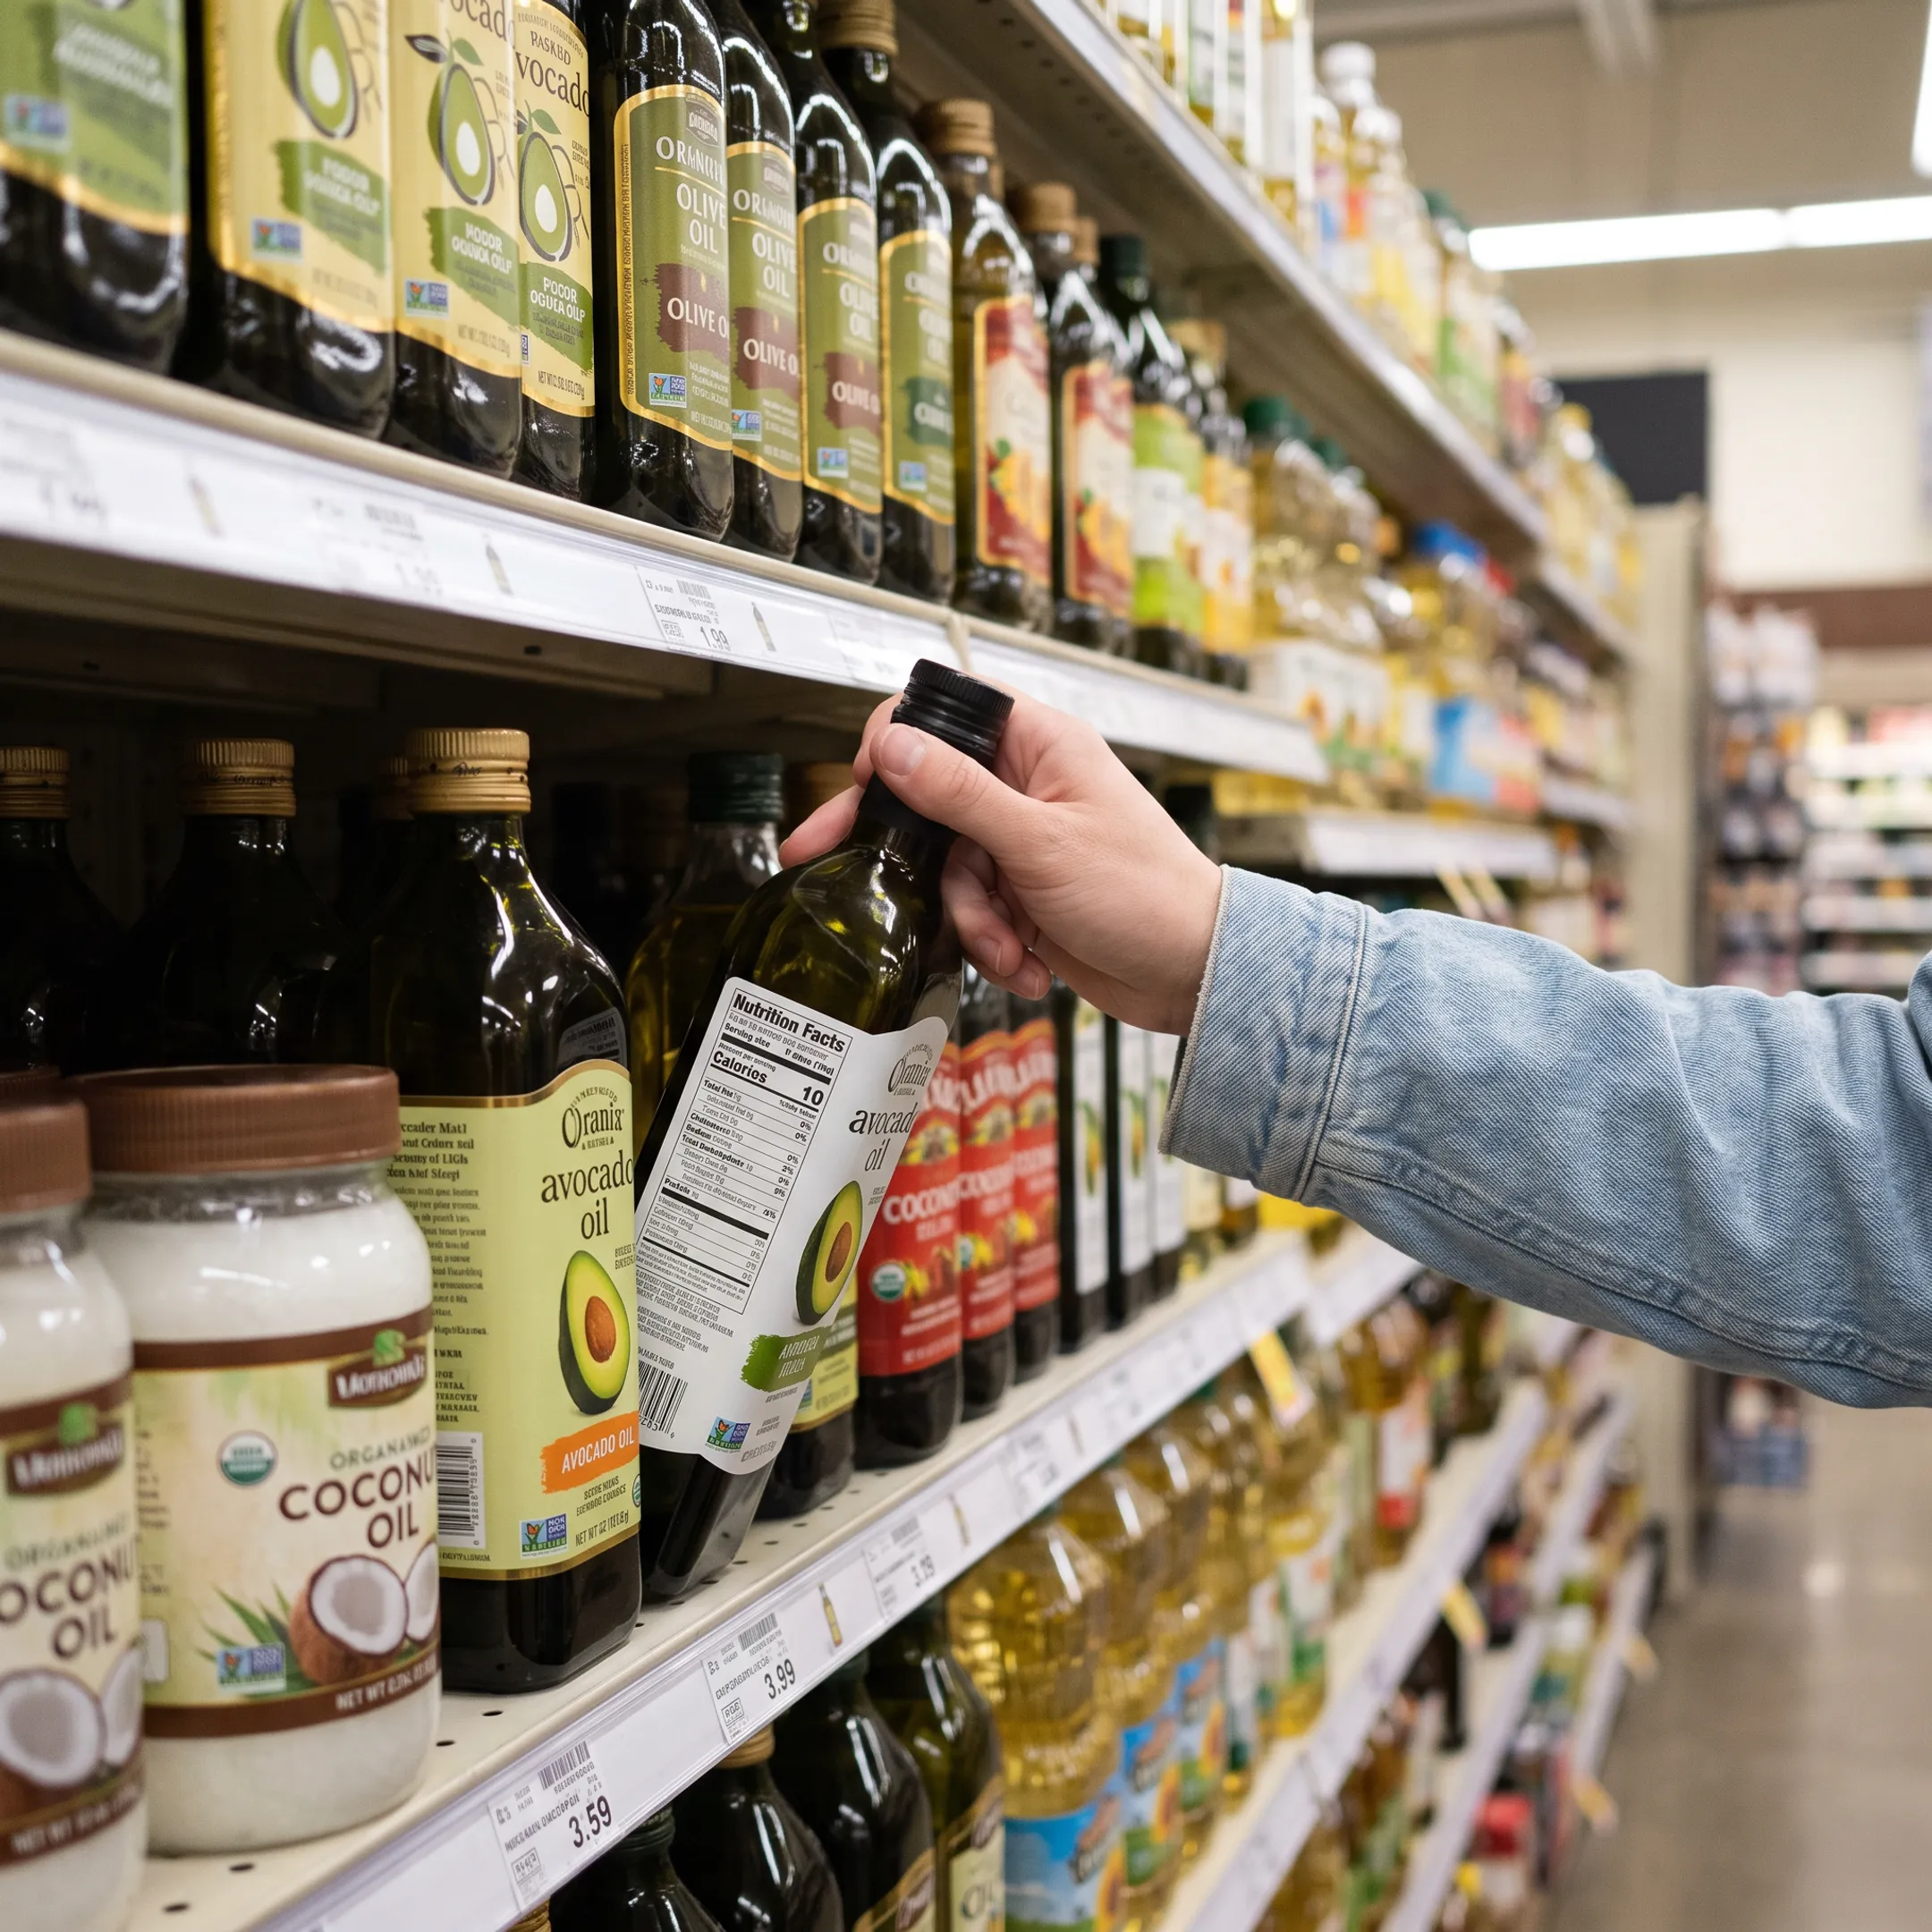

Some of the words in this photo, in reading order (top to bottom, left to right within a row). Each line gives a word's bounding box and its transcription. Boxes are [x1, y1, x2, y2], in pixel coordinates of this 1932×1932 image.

[677, 182, 726, 230] OLIVE
[690, 219, 719, 254] OIL
[752, 233, 798, 274] OLIVE
[763, 267, 790, 298] OIL
[667, 298, 716, 334] OLIVE
[743, 338, 786, 372] OLIVE
[699, 626, 731, 651] 1.99
[733, 993, 799, 1033] Nutrition
[802, 1022, 845, 1053] Facts
[713, 1051, 767, 1084] Calories
[803, 1086, 824, 1106] 10
[865, 1138, 891, 1172] oil
[581, 1197, 609, 1240] oil
[562, 1434, 615, 1473] AVOCADO
[619, 1426, 634, 1449] OIL
[279, 1448, 436, 1521] COCONU
[367, 1501, 419, 1548] OIL
[52, 1602, 115, 1659] OIL
[765, 1658, 796, 1699] 3.99
[569, 1795, 612, 1848] 3.59
